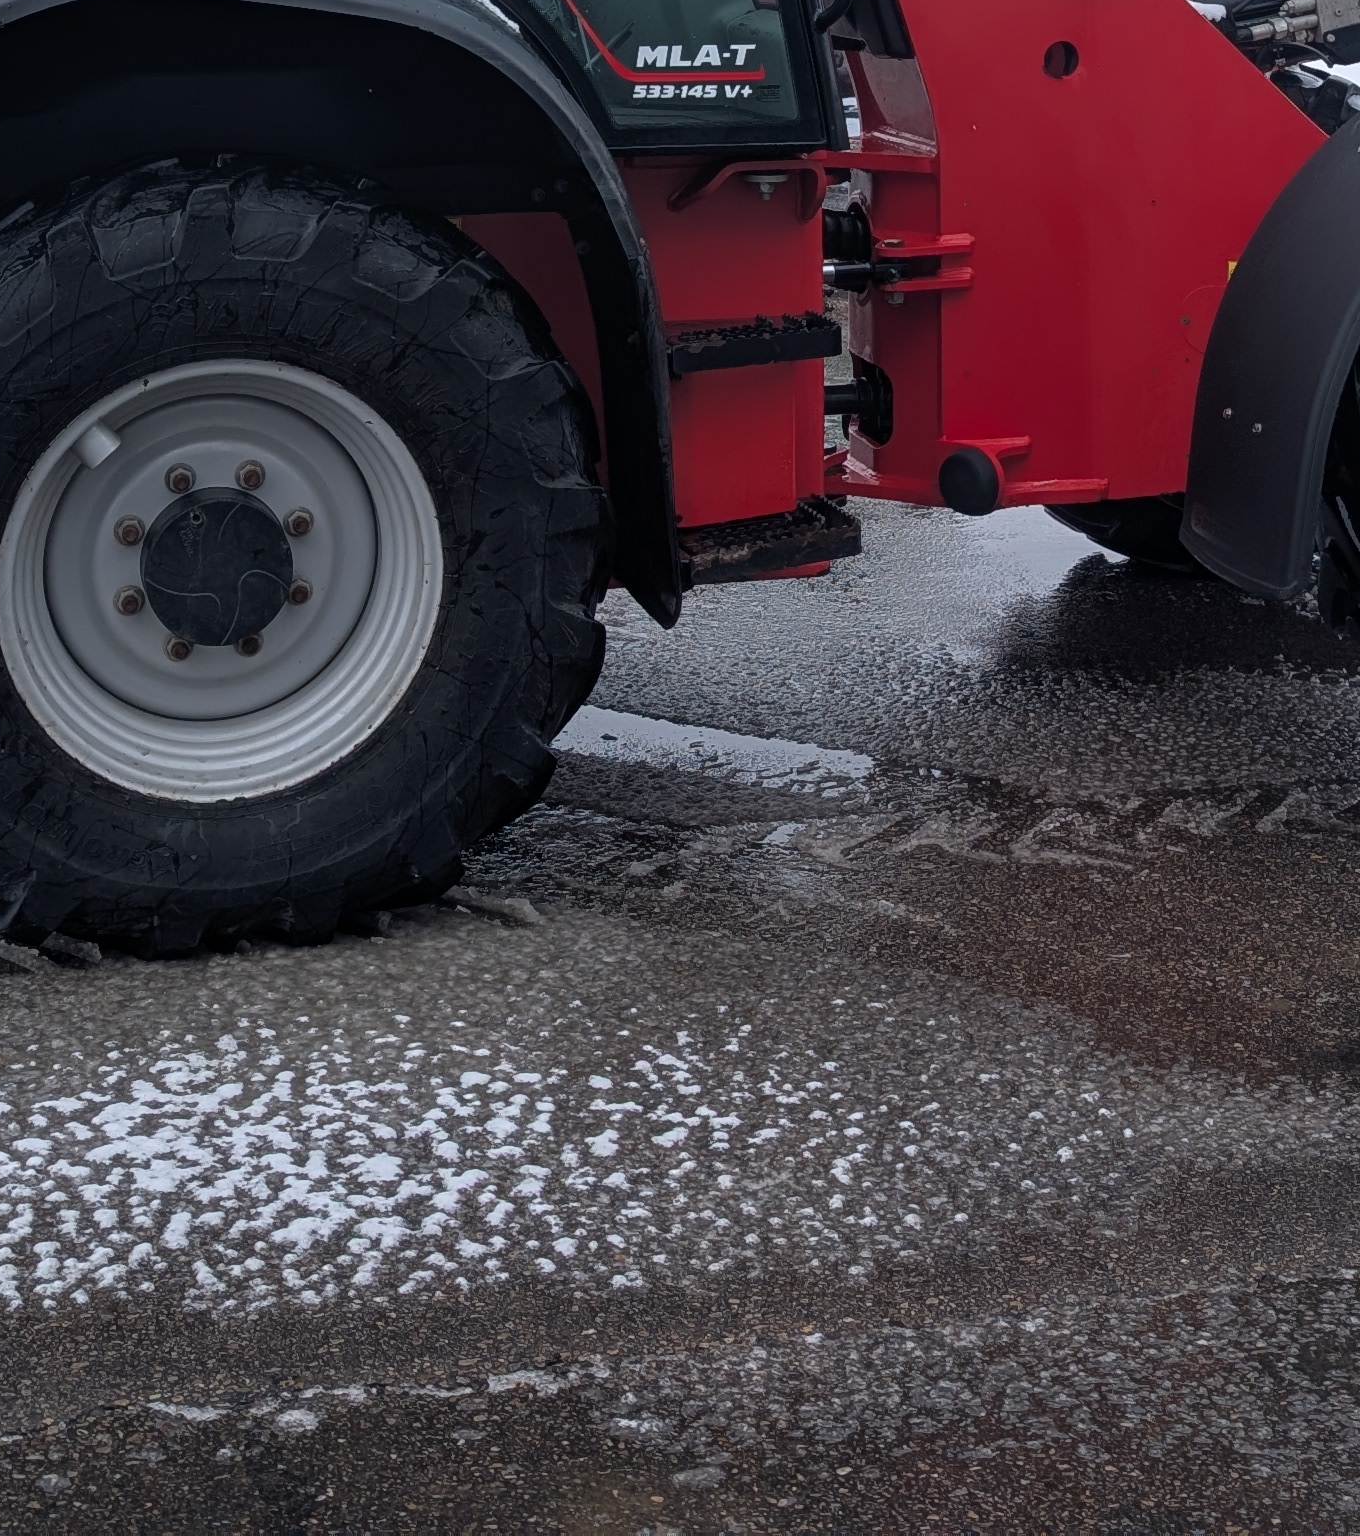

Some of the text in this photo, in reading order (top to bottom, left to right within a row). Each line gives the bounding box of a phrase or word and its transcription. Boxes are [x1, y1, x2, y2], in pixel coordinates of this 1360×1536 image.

[635, 44, 757, 67] MLA-T
[632, 84, 719, 99] 533-145
[723, 84, 754, 99] V+
